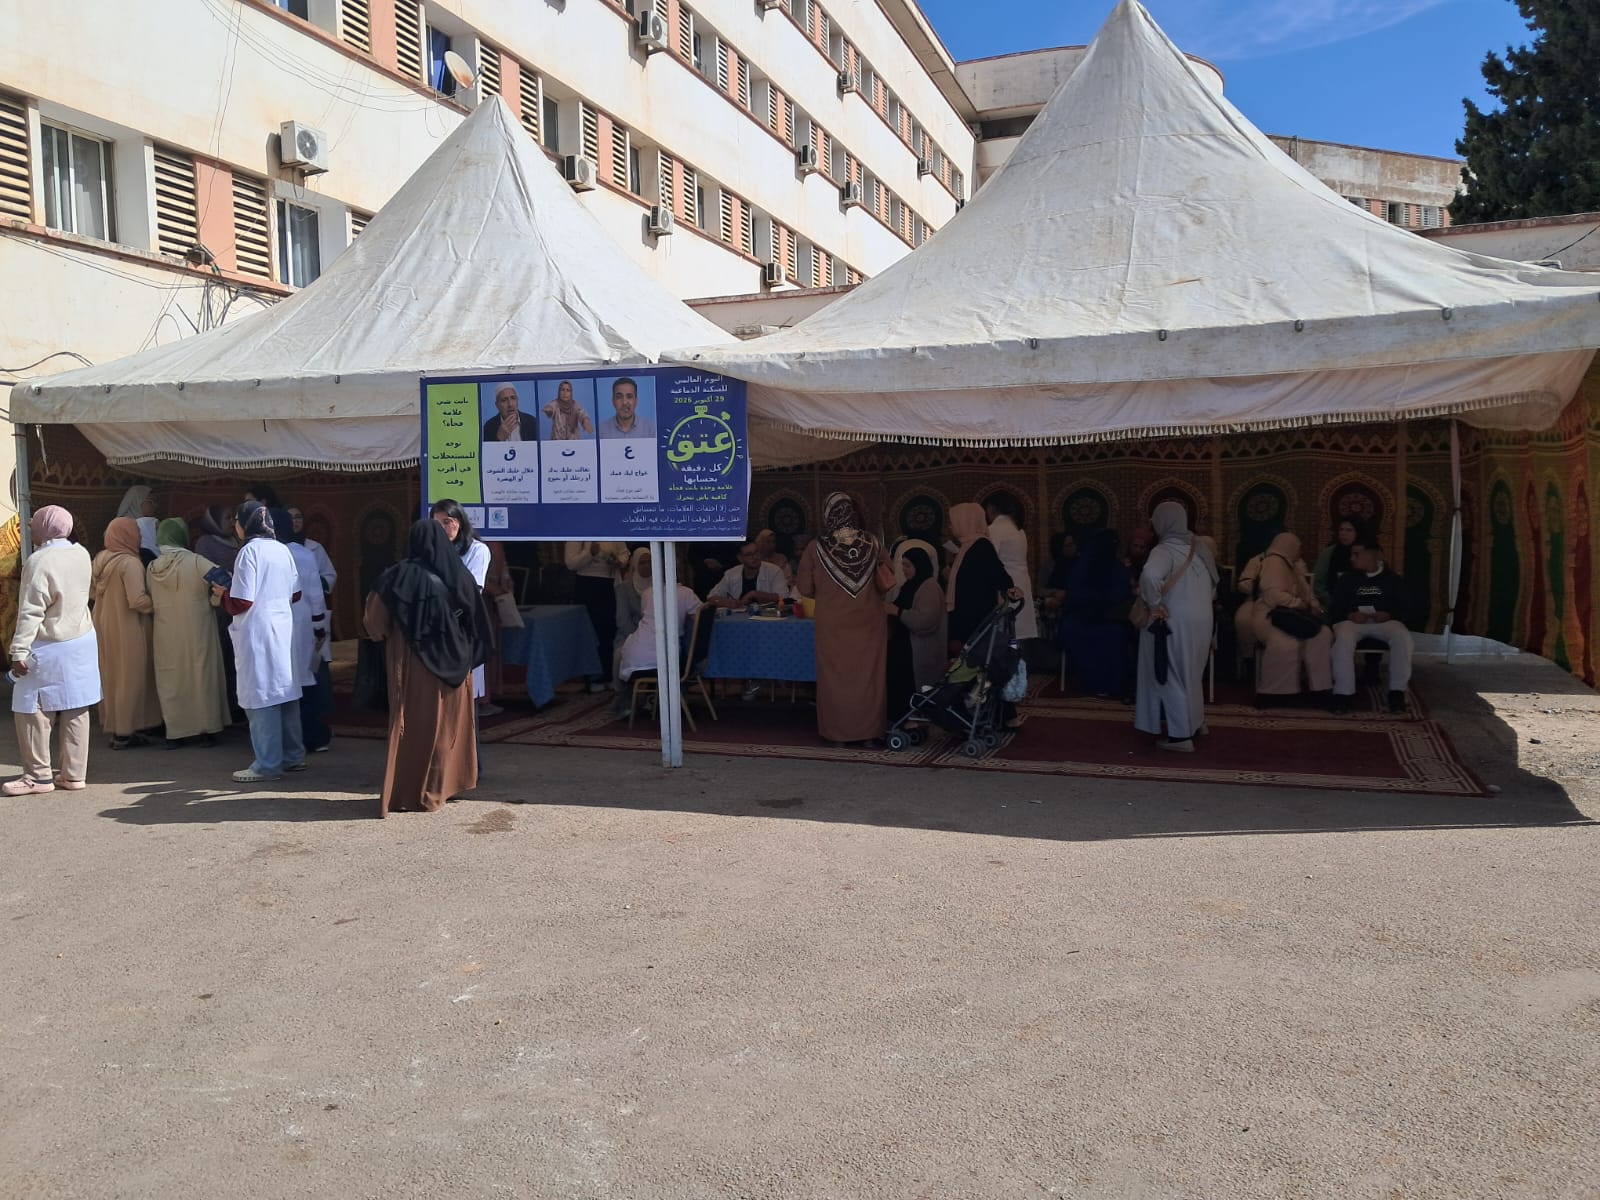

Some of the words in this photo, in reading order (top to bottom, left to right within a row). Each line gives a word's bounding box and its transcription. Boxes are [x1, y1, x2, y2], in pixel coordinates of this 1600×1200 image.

[674, 375, 702, 385] العالمي
[714, 395, 725, 403] 29
[667, 431, 732, 463] عتق
[504, 446, 516, 461] ق
[561, 449, 575, 457] ت
[624, 445, 635, 460] ع
[709, 463, 722, 473] كل
